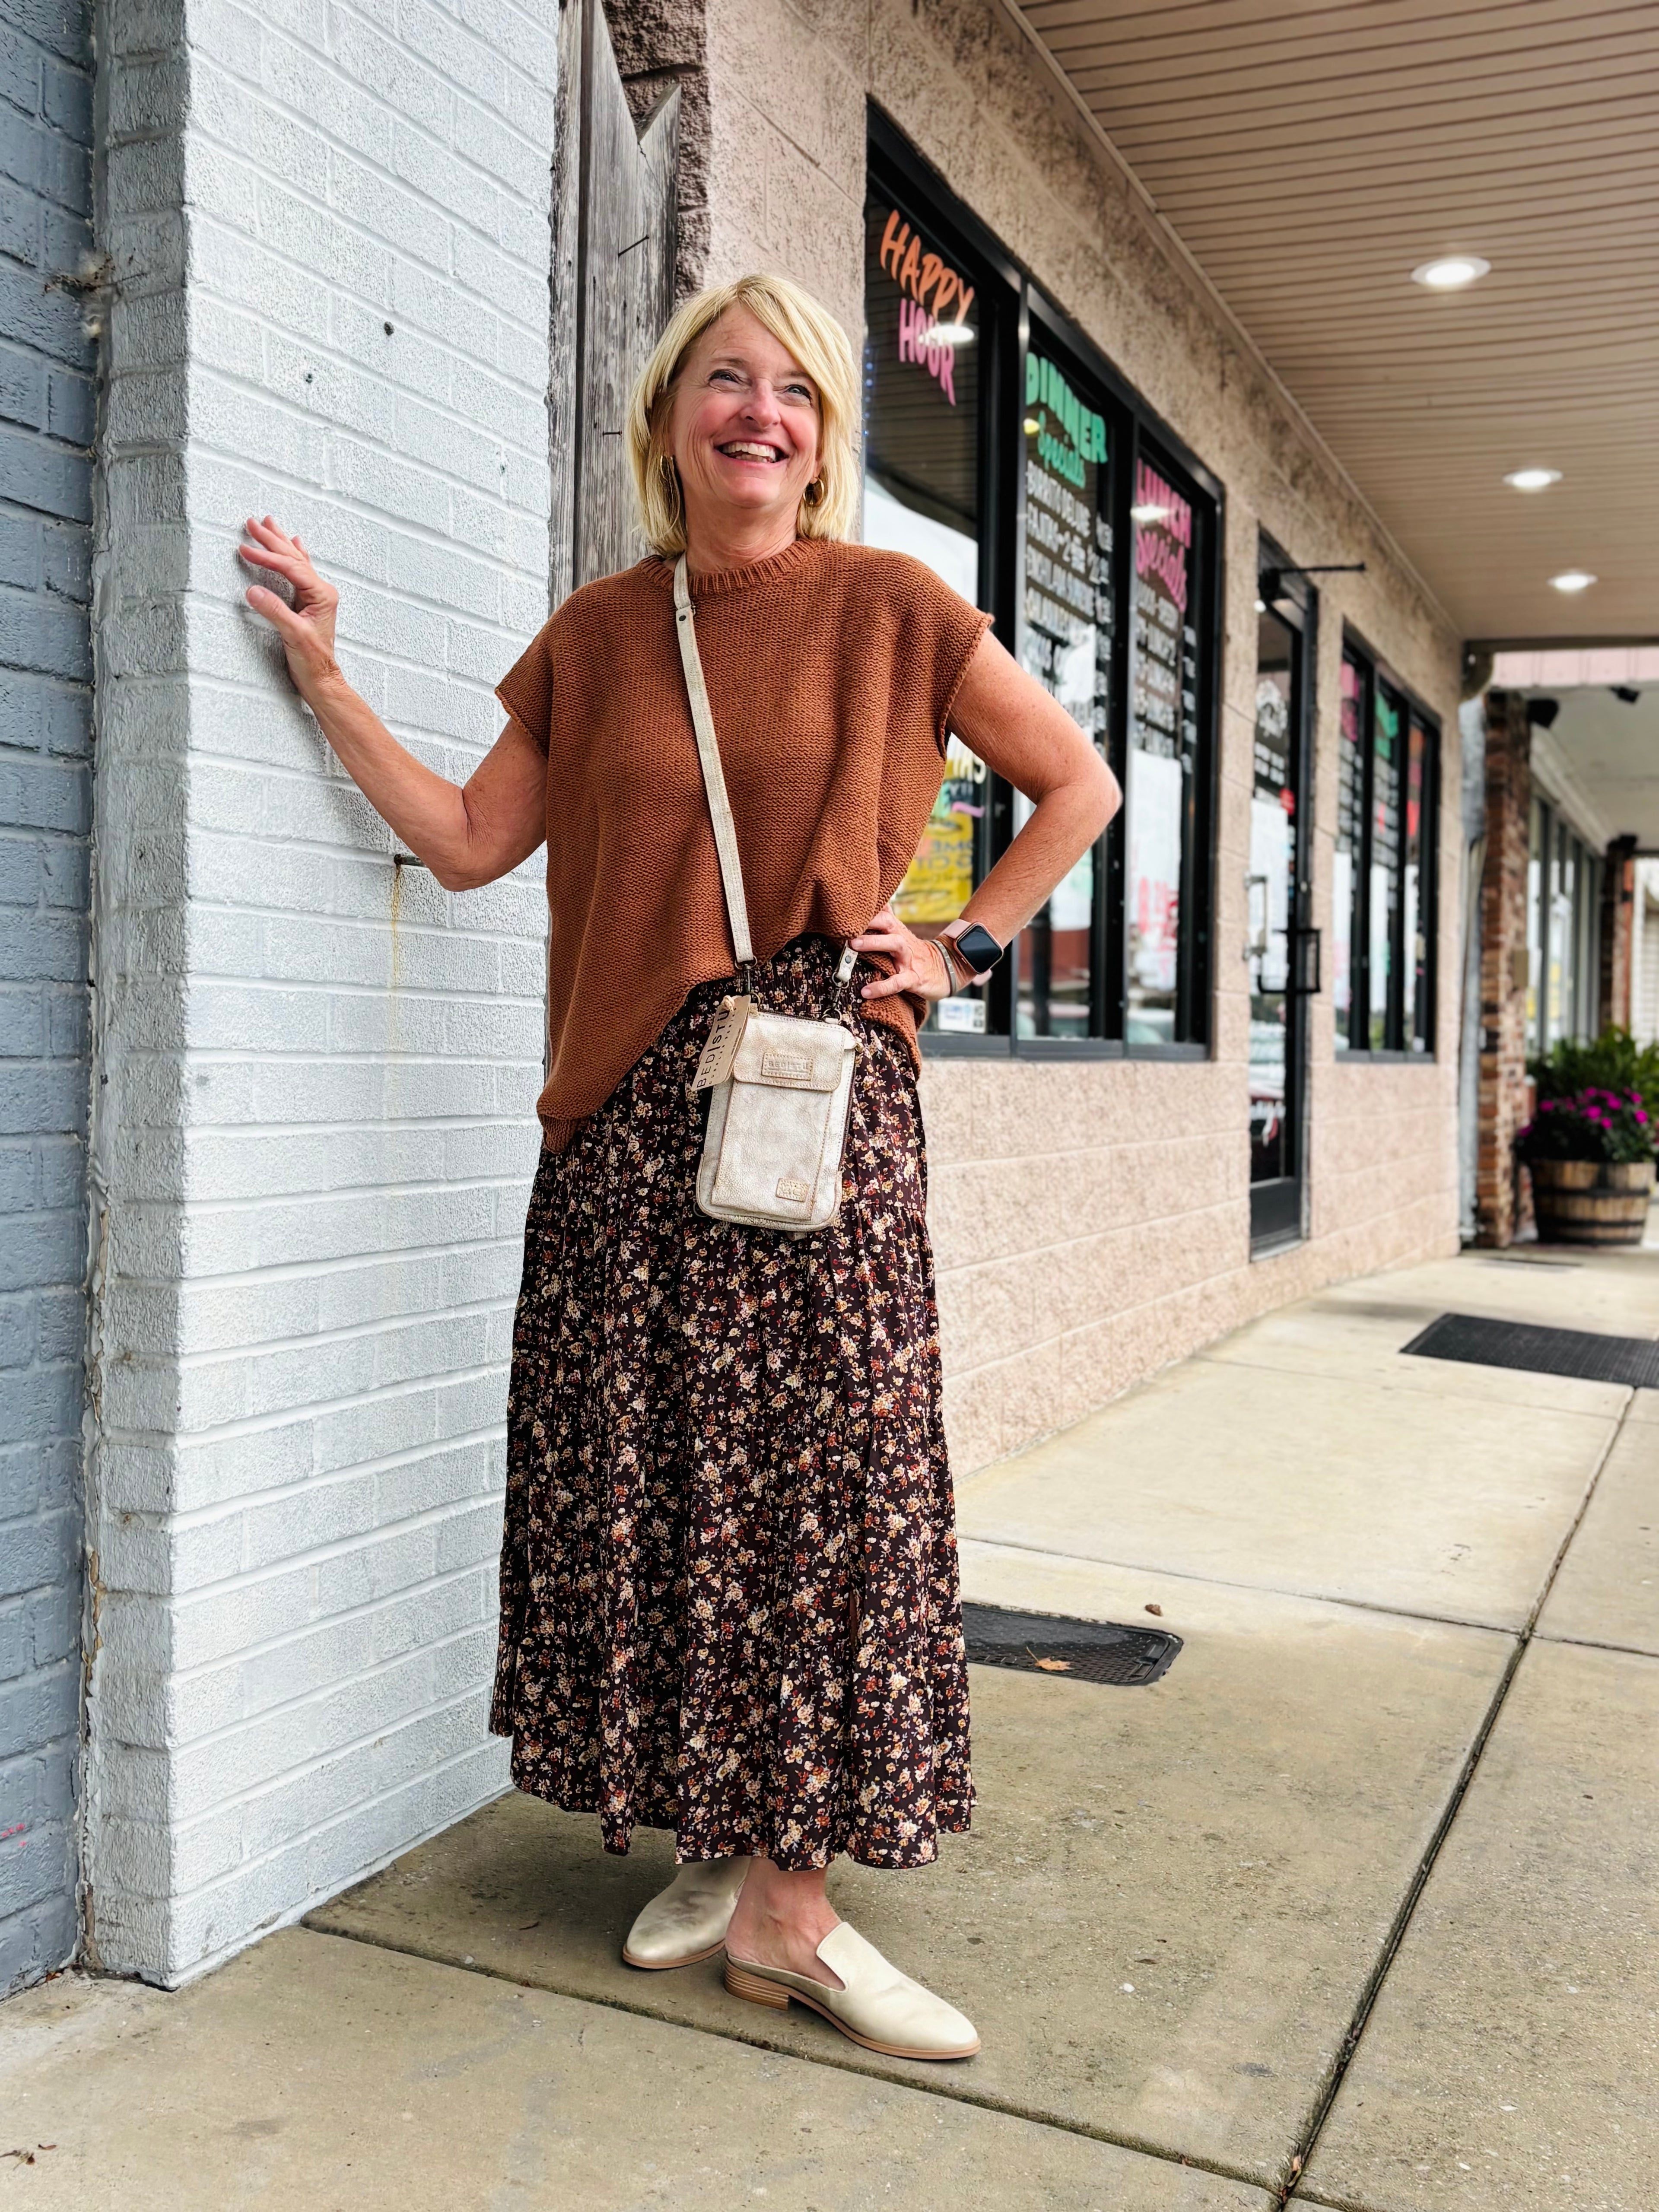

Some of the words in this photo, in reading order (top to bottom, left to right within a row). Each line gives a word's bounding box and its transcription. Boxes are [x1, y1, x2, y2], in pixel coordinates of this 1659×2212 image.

[880, 209, 974, 327] HAPPY
[899, 298, 957, 407] HOUR
[1025, 352, 1109, 464] DINNER
[1137, 458, 1192, 549] LUNCH
